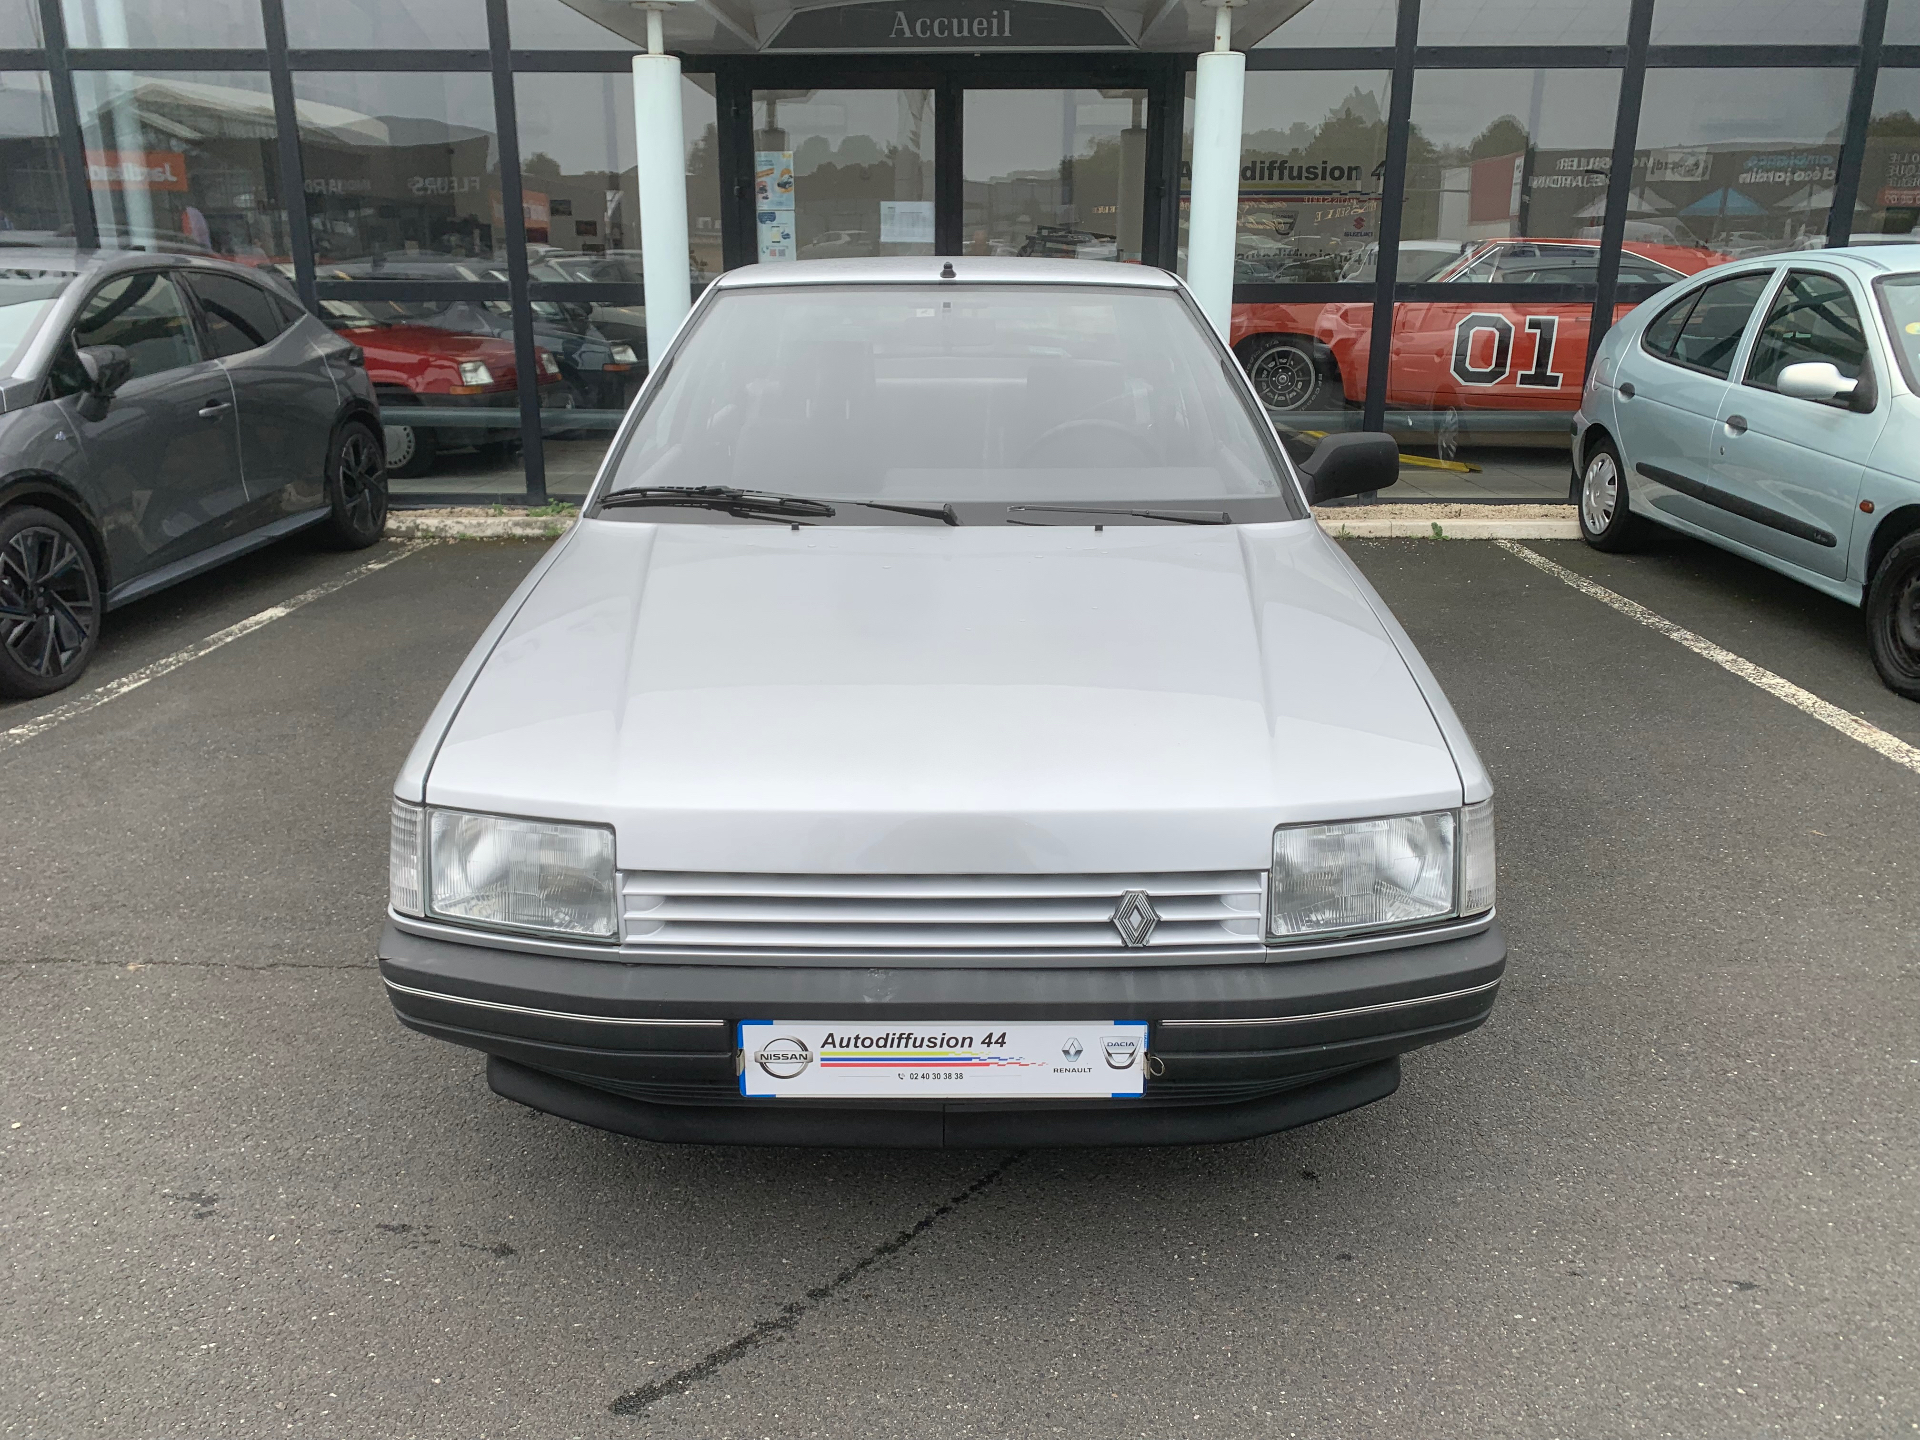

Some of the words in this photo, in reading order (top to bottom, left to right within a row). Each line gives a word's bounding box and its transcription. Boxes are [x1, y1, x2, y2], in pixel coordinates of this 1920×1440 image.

[889, 10, 1012, 38] Accueil
[1181, 160, 1362, 181] Adiffusion
[1371, 160, 1386, 181] 4
[1450, 312, 1563, 390] 01
[820, 1032, 974, 1049] Autodiffusion
[981, 1032, 1007, 1048] 44
[760, 1053, 808, 1061] NISSAN
[909, 1072, 919, 1080] 02
[920, 1072, 930, 1080] 40
[931, 1072, 941, 1080] 30
[943, 1072, 952, 1080] 38
[954, 1072, 964, 1080] 38
